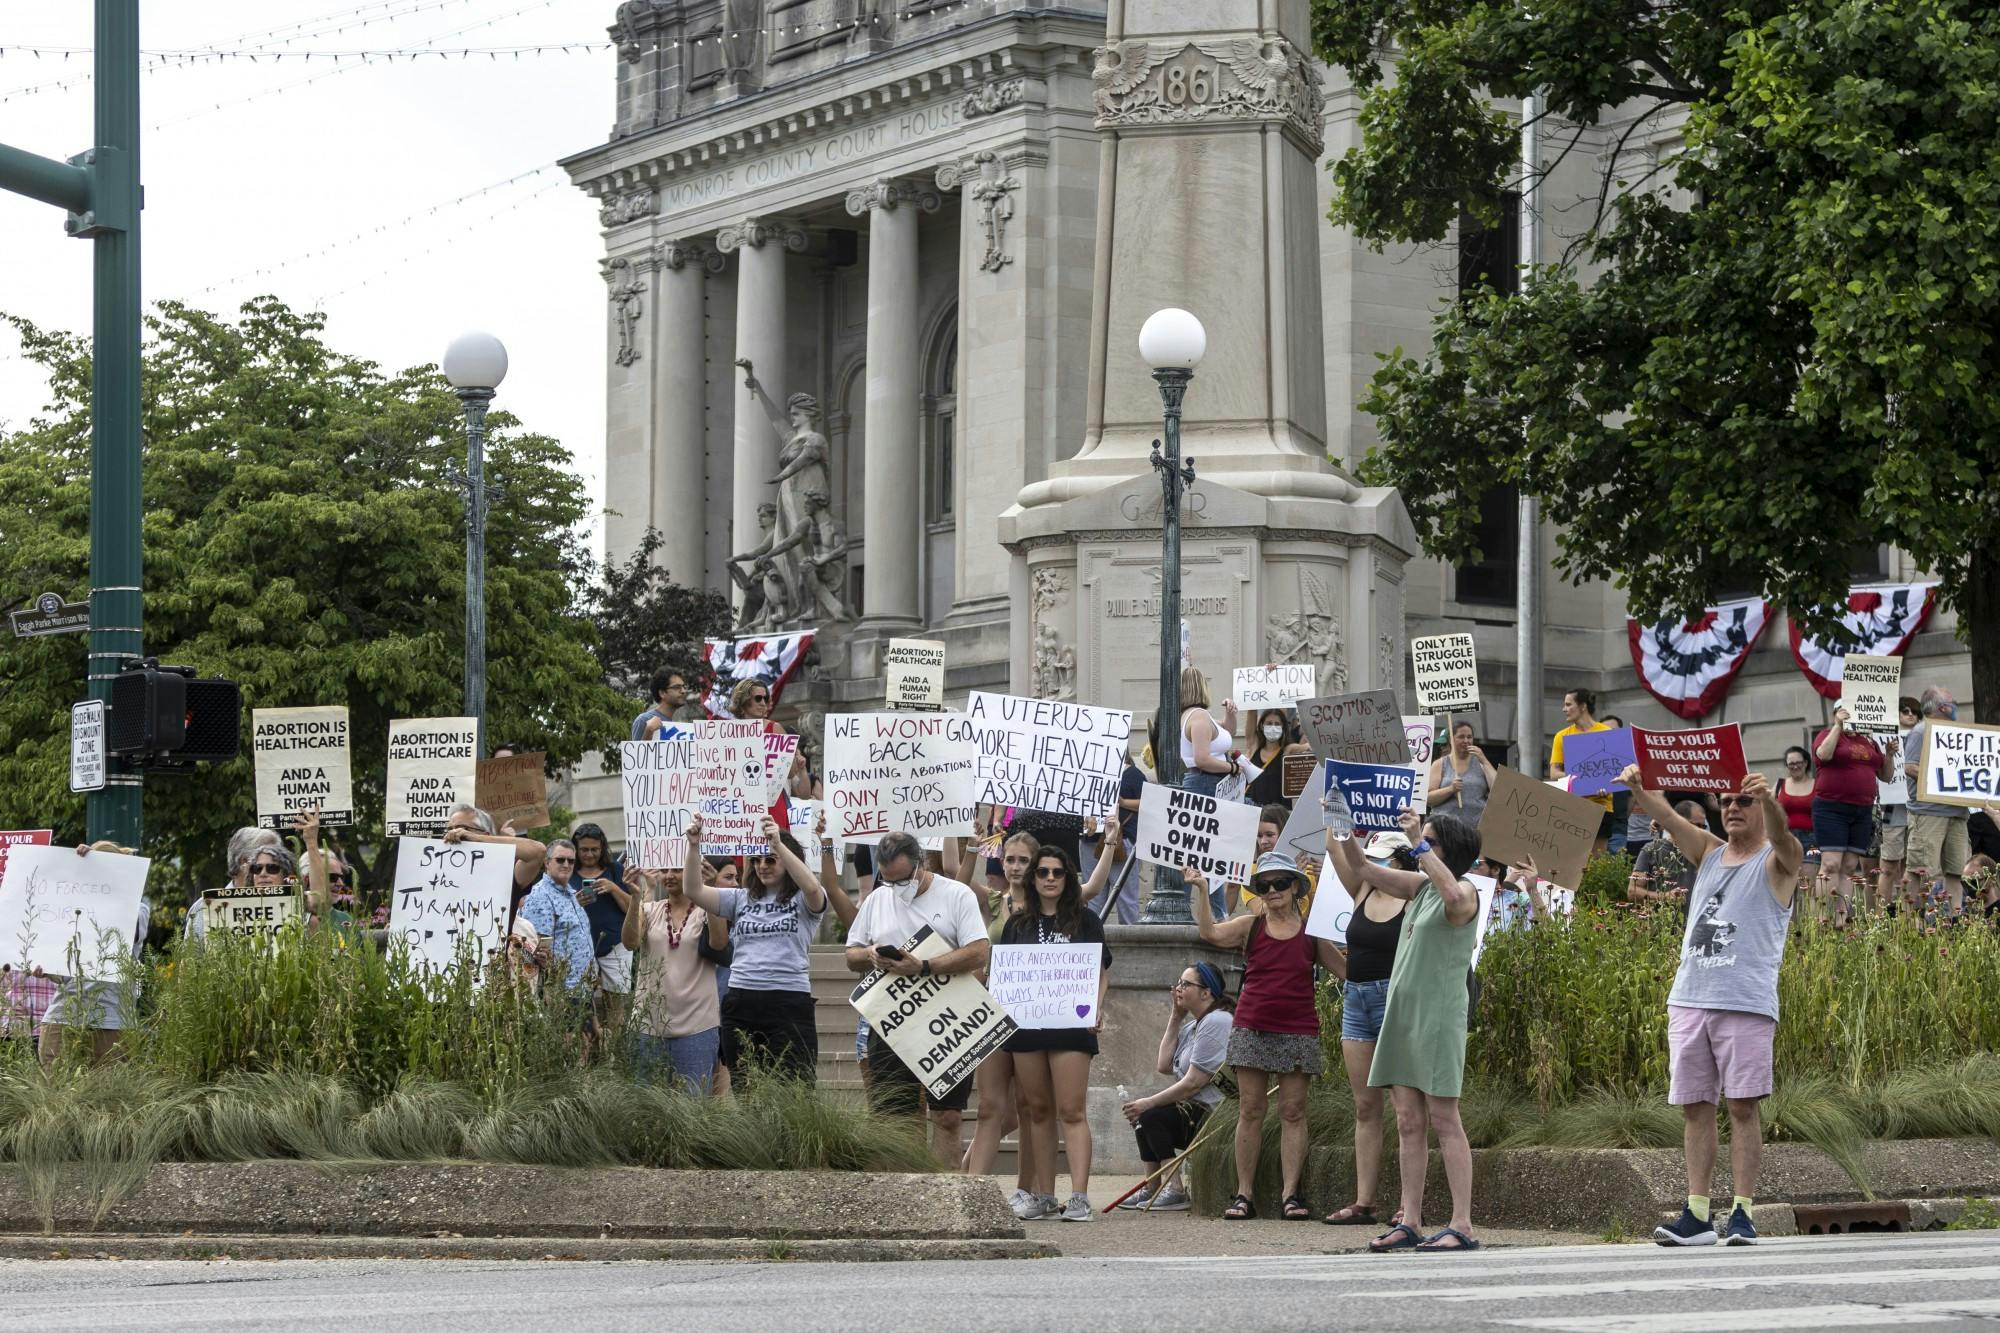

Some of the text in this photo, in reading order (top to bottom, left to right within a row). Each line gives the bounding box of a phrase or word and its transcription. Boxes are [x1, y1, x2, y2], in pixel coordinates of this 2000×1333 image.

[1155, 64, 1221, 105] 1861
[669, 100, 961, 207] MONROE COUNTY COURT HOUSE
[1106, 597, 1213, 617] PAUL POST
[1415, 636, 1470, 650] ONLY THE
[890, 647, 934, 656] ABORTION
[1415, 647, 1473, 662] STRUGGLE
[889, 656, 942, 666] HEALTHCARE
[1417, 659, 1473, 673] HAS WON
[1844, 664, 1899, 674] ABORTION IS
[902, 675, 928, 684] AND A
[1237, 666, 1312, 684] ABORTION
[1843, 673, 1898, 683] HEALTHCARE
[899, 684, 930, 692] HUMAN
[1418, 676, 1475, 691] WOMEN'S
[902, 692, 927, 701] RIGHT
[1243, 688, 1305, 702] FOR ALL
[1428, 689, 1468, 702] RIGHTS
[1857, 695, 1884, 704] AND A
[1309, 698, 1374, 728] SCOTUS
[1854, 704, 1887, 713] HUMAN
[74, 709, 101, 726] SIDEWALK
[972, 695, 1130, 740] A UTERUS IS
[1858, 713, 1883, 722] RIGHT
[256, 721, 347, 736] ABORTION IS
[720, 720, 762, 738] cannot
[834, 717, 973, 742] WE WONT GO
[1317, 720, 1387, 745] has its
[80, 740, 95, 754] ZONE
[255, 735, 345, 751] HEALTHCARE
[391, 732, 474, 746] ABORTION IS
[1644, 733, 1716, 746] KEEP YOUR
[1935, 731, 1974, 752] KEEP
[1980, 736, 1995, 752] IT
[389, 746, 471, 760] HEALTHCARE
[623, 741, 696, 770] SOMEONE
[695, 744, 754, 763] live in a
[869, 741, 925, 762] BACK
[972, 728, 1127, 779] MORE HEAVILY
[1647, 749, 1720, 760] THEOCRACY
[1579, 757, 1622, 772] NEVER
[1946, 753, 1960, 767] by
[281, 767, 326, 780] AND A
[696, 763, 737, 785] country
[829, 760, 972, 783] BANNING ABORTIONS
[1666, 763, 1710, 775] OFF MY
[277, 782, 331, 795] HUMAN
[410, 778, 452, 790] AND A
[978, 756, 1121, 807] EGULATED THAN
[1374, 773, 1411, 791] THIS
[1656, 776, 1731, 789] DEMOCRACY
[406, 791, 455, 804] HUMAN
[625, 772, 698, 808] YOU LOVE
[697, 782, 744, 798] where a
[892, 782, 944, 804] STOPS
[284, 796, 326, 810] RIGHT
[699, 799, 764, 815] CORPSE has
[981, 780, 1112, 818] ASSAULT RIFLE
[1169, 790, 1217, 815] MIND
[1350, 791, 1406, 810] IS NOT A
[411, 805, 450, 818] RIGHT
[1353, 811, 1399, 828] CHURC
[627, 808, 691, 838] HAS HAD
[724, 816, 755, 832] bodily
[843, 807, 977, 834] SAFE ABORTION
[1166, 808, 1220, 836] YOUR
[5, 834, 33, 844] YOUR
[1168, 829, 1210, 853] OWN
[627, 840, 640, 868] AN
[700, 844, 769, 855] LIVING PEOPLE
[420, 845, 485, 874] STOP
[1150, 843, 1246, 883] UTERUS!!!
[56, 880, 112, 895] FORCED
[429, 872, 459, 889] the
[217, 889, 232, 897] NO
[232, 907, 274, 922] FREE
[994, 952, 1026, 968] NEVER
[860, 977, 875, 990] NO
[885, 974, 920, 1001] FRE
[880, 974, 957, 1037] ABORTIO
[928, 1006, 959, 1036] ON
[918, 1001, 995, 1074] DEMAND!
[947, 1020, 1008, 1077] Party for Socialism and
[952, 1057, 981, 1082] Liberation
